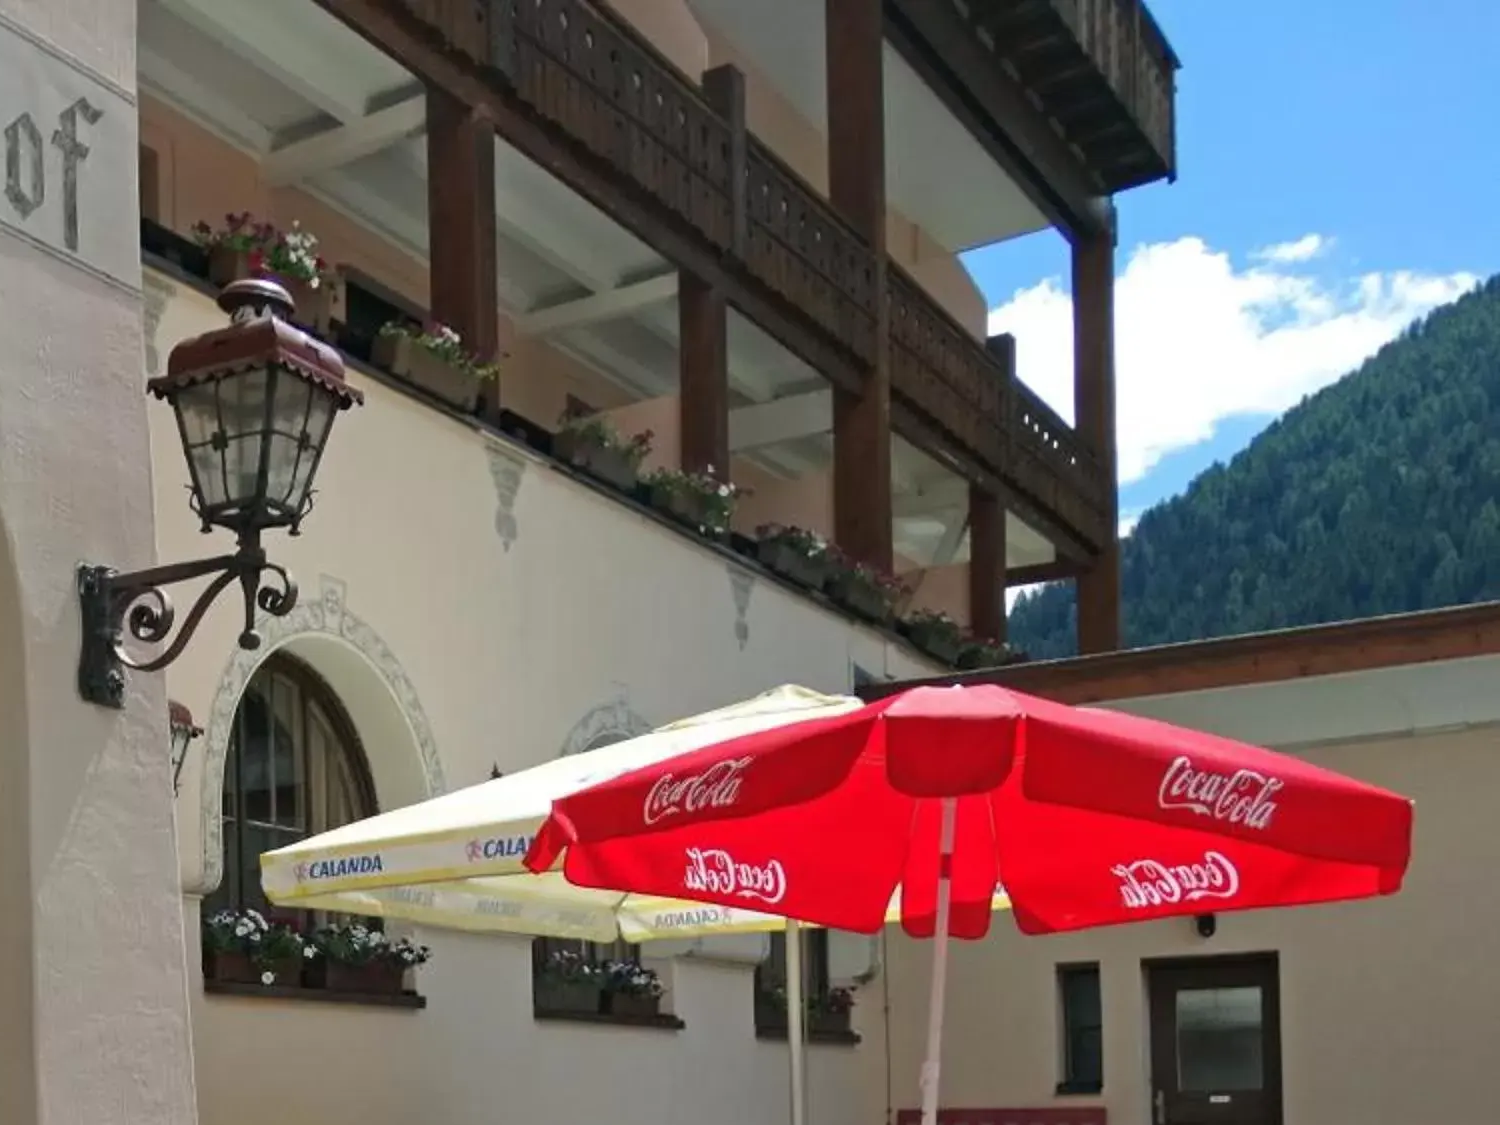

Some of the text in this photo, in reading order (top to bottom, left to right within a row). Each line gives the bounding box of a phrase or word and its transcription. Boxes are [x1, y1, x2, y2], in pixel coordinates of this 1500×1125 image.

[643, 754, 756, 825] Coca-Cola
[1159, 755, 1284, 829] Coca-Cola
[309, 853, 383, 879] CALANDA
[483, 834, 536, 859] CALA
